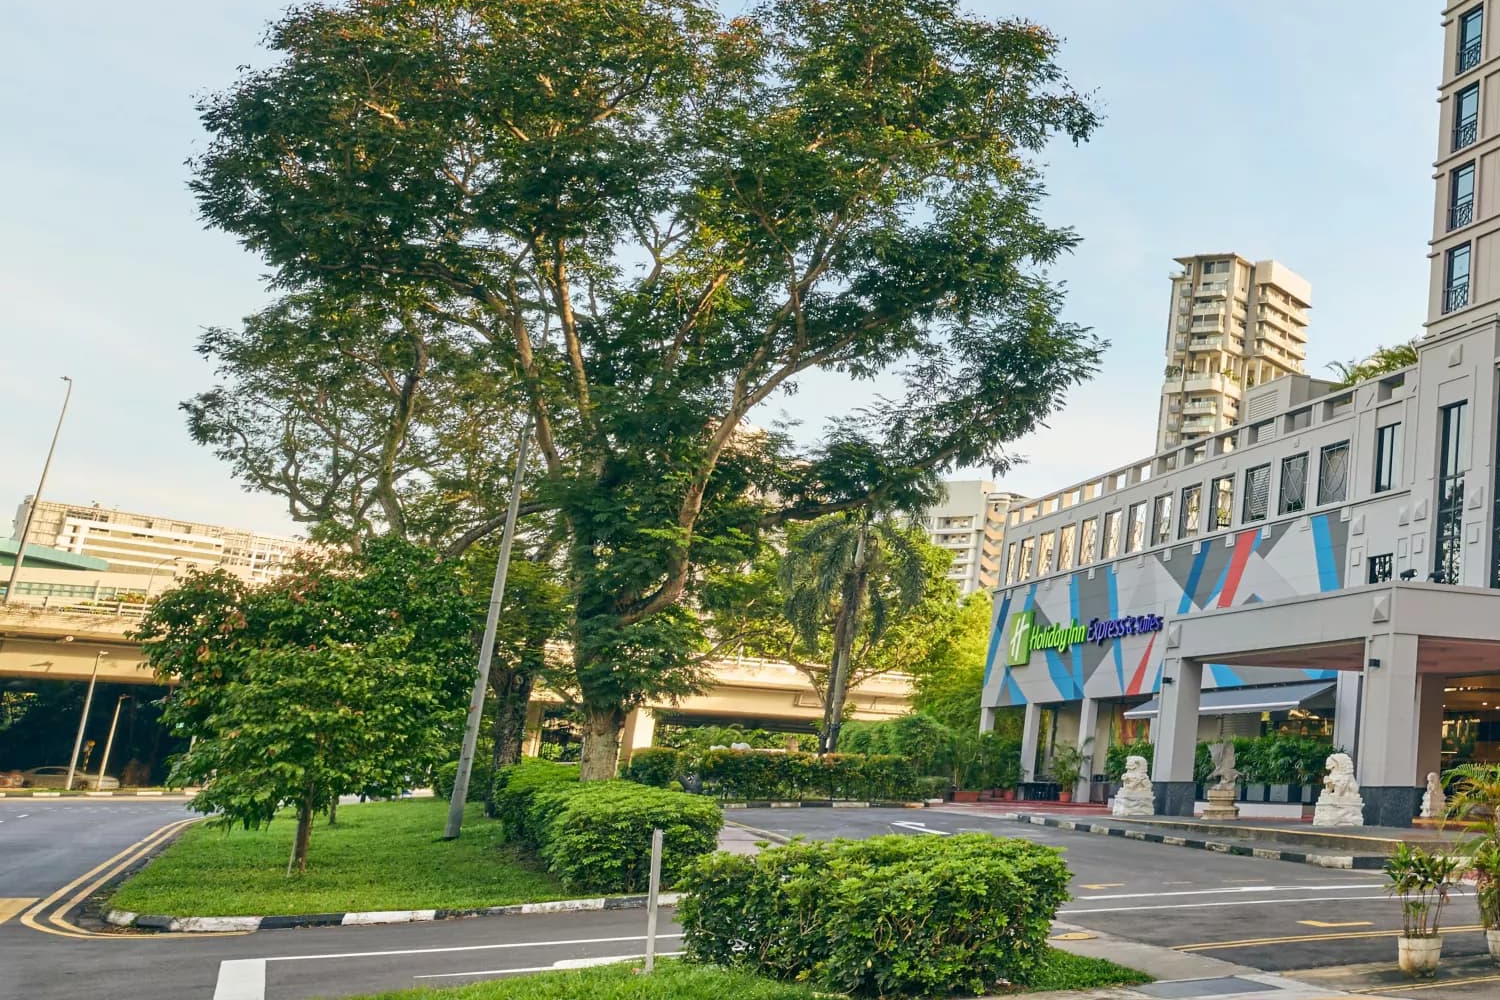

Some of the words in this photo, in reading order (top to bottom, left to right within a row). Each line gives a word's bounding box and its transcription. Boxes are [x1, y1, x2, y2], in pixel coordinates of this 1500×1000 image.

[1029, 621, 1067, 652] Holiday
[1067, 619, 1086, 643] Inn
[1086, 617, 1125, 645] Express
[1125, 615, 1134, 635] &
[1135, 613, 1164, 634] Suites
